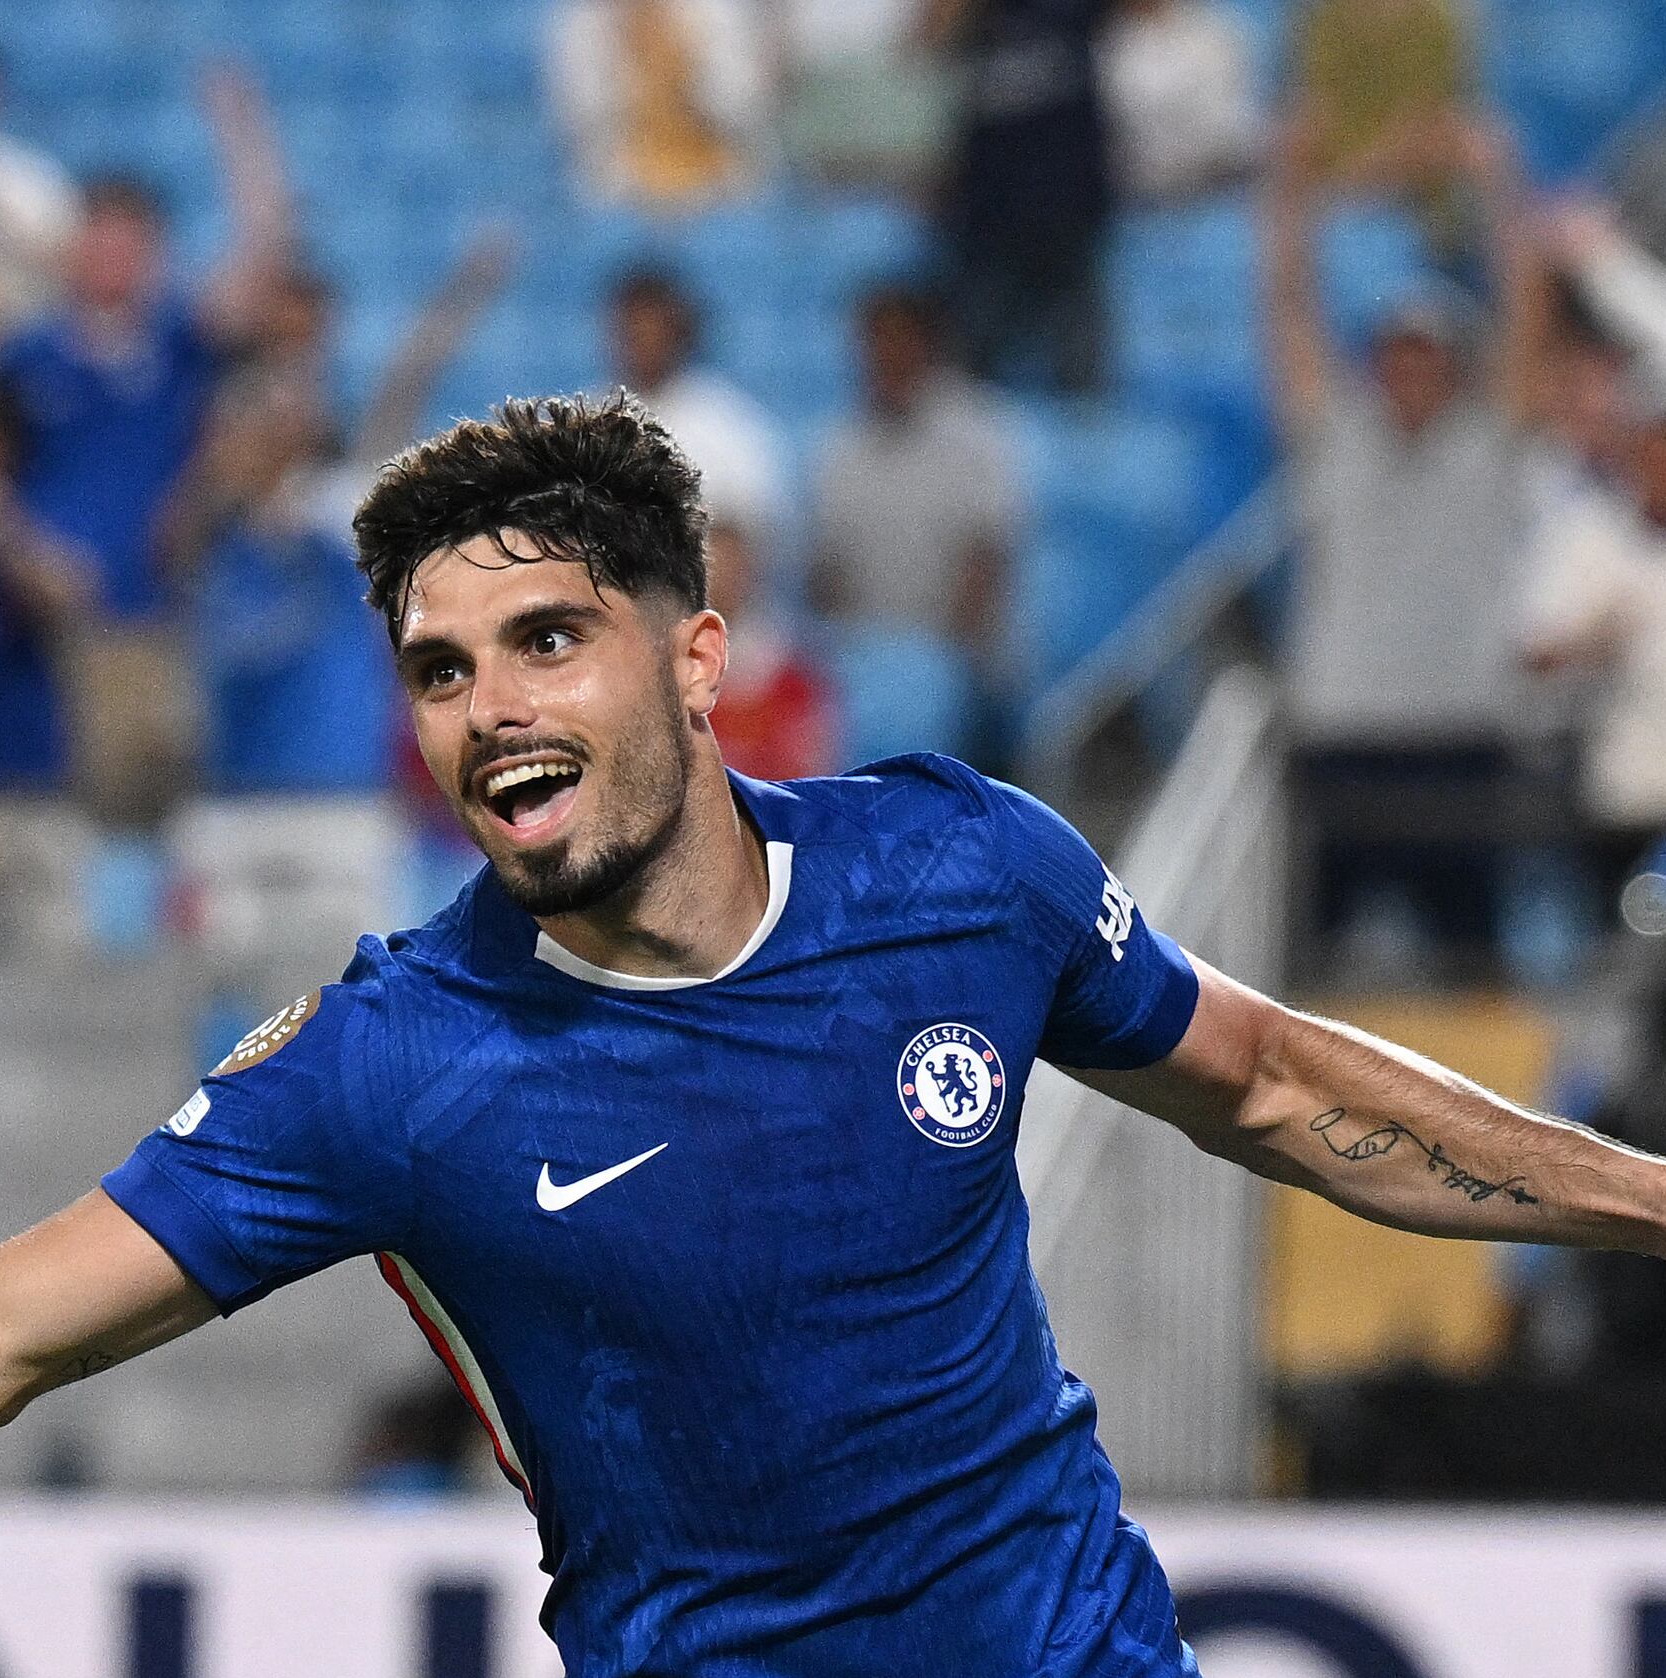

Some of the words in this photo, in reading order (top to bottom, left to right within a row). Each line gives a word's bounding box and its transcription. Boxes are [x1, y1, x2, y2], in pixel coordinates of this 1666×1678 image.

[906, 1027, 971, 1067] CHELSEA
[934, 1127, 980, 1140] FOOTBALL
[982, 1104, 997, 1127] CLUB
